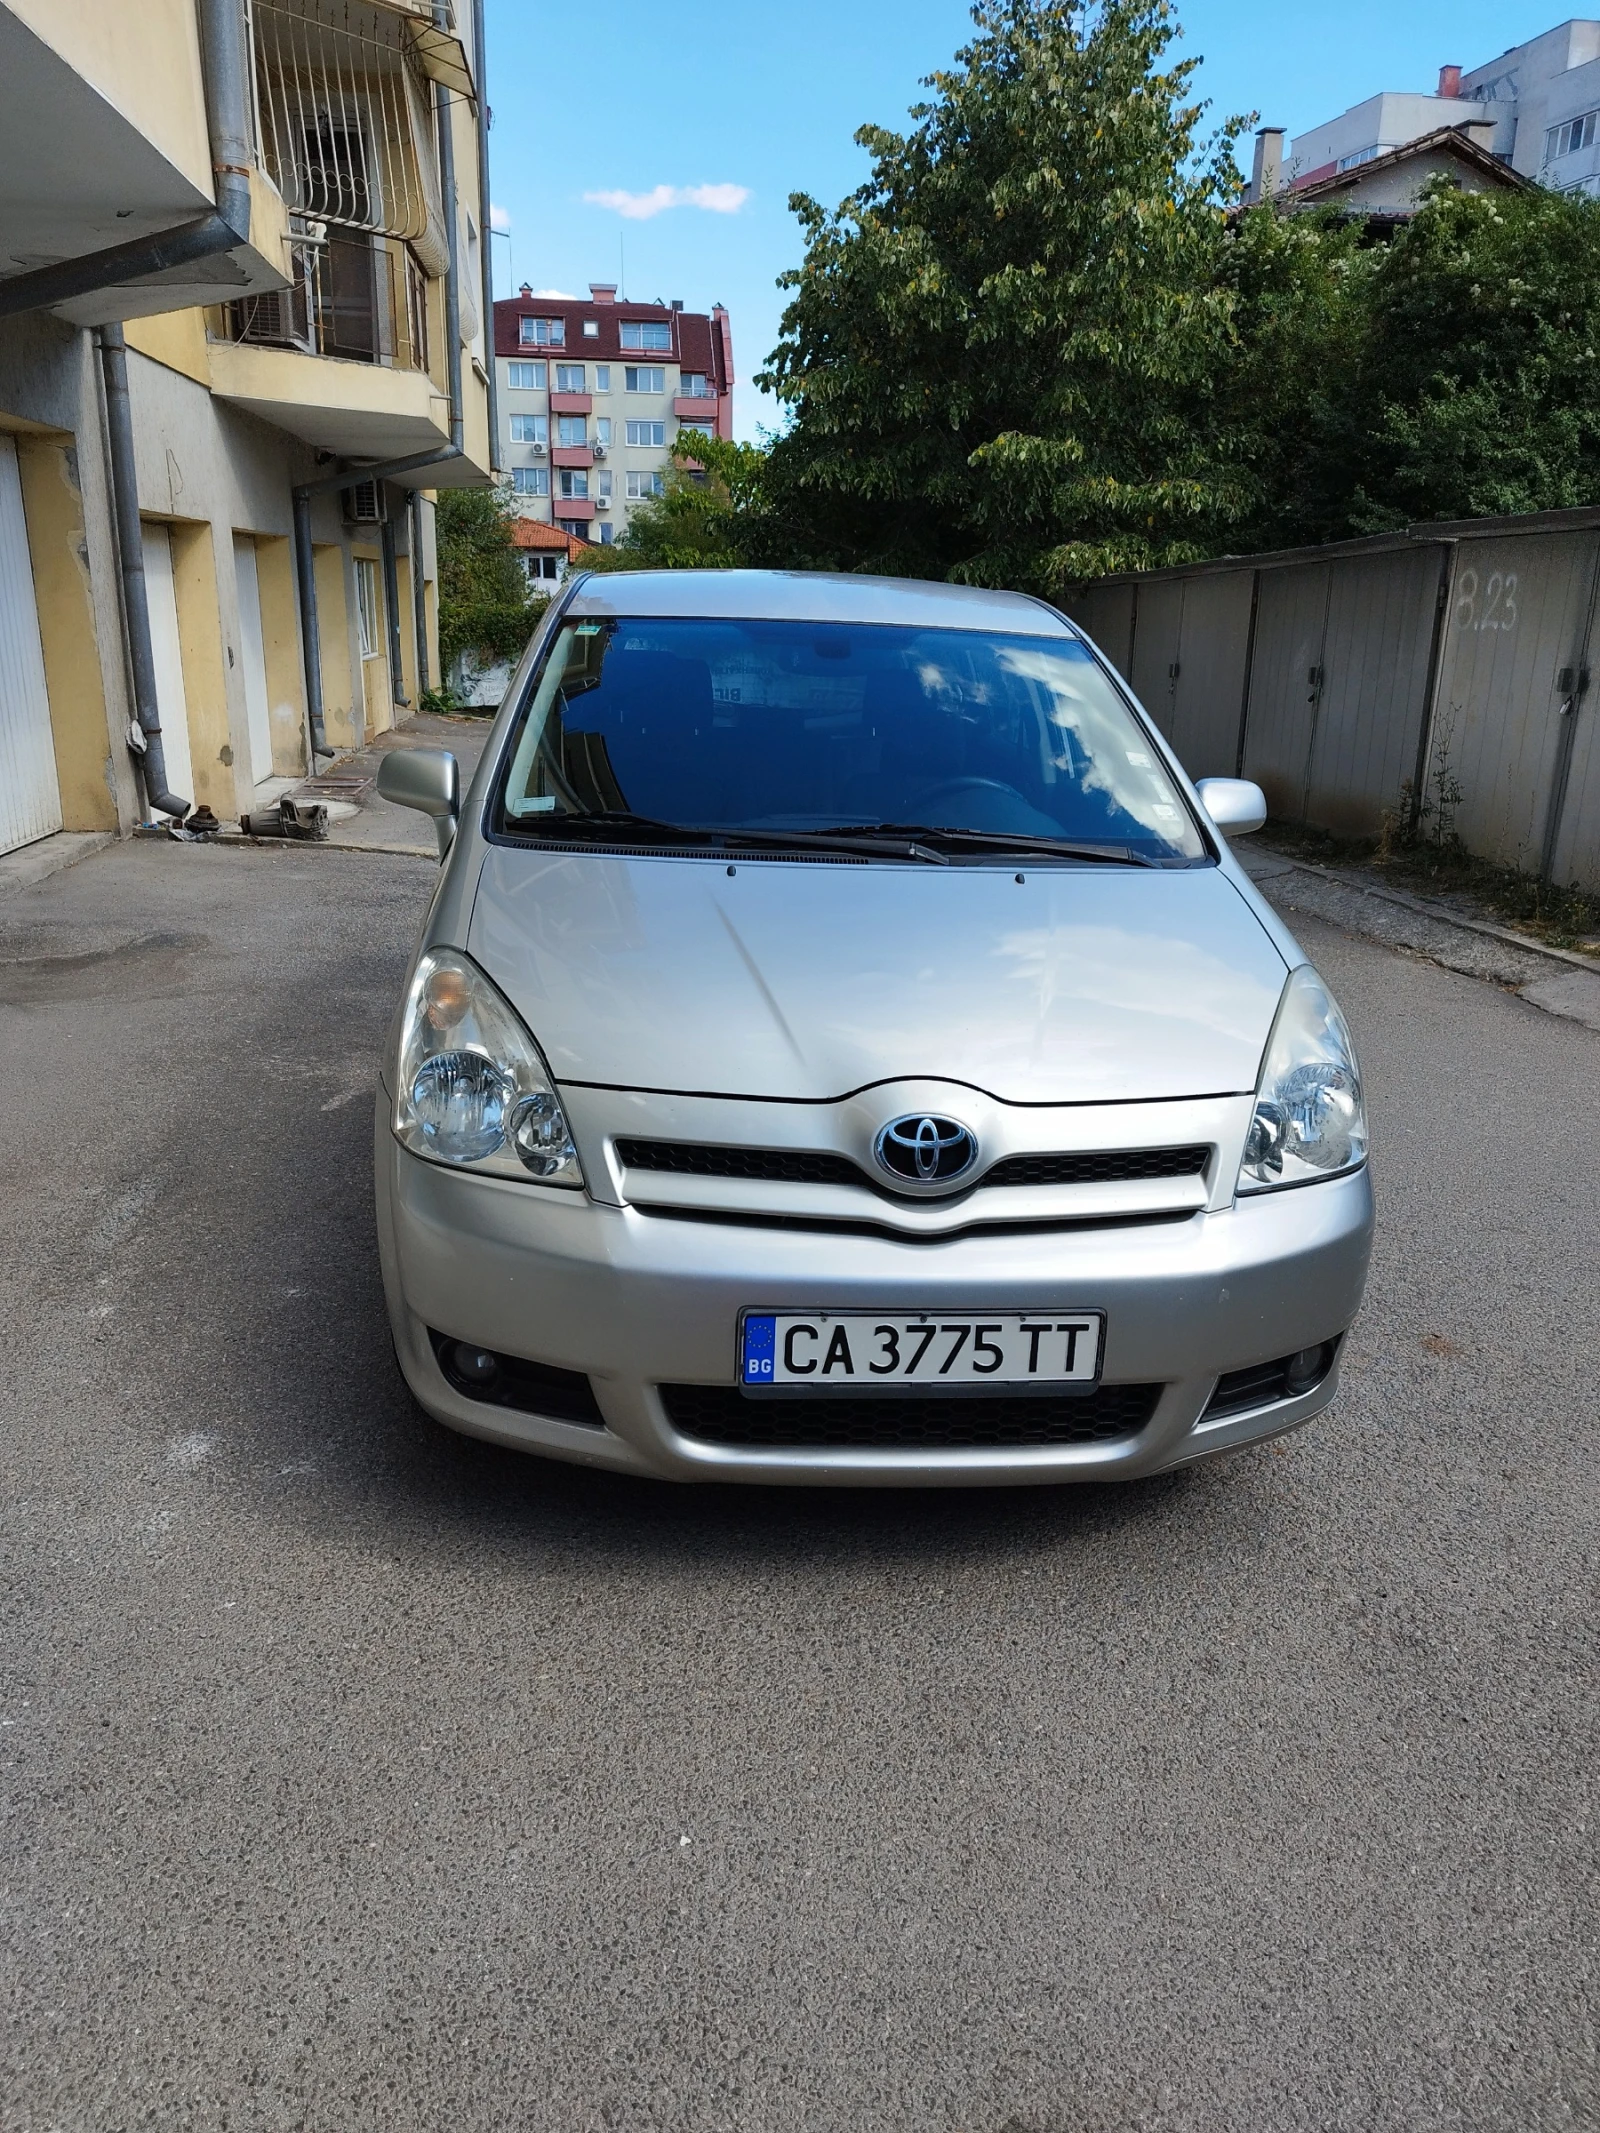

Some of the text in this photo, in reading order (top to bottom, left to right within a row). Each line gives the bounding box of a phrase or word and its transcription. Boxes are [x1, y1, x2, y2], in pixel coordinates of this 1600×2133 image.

[784, 1324, 1090, 1374] CA 3775 TT
[749, 1359, 771, 1373] BG
